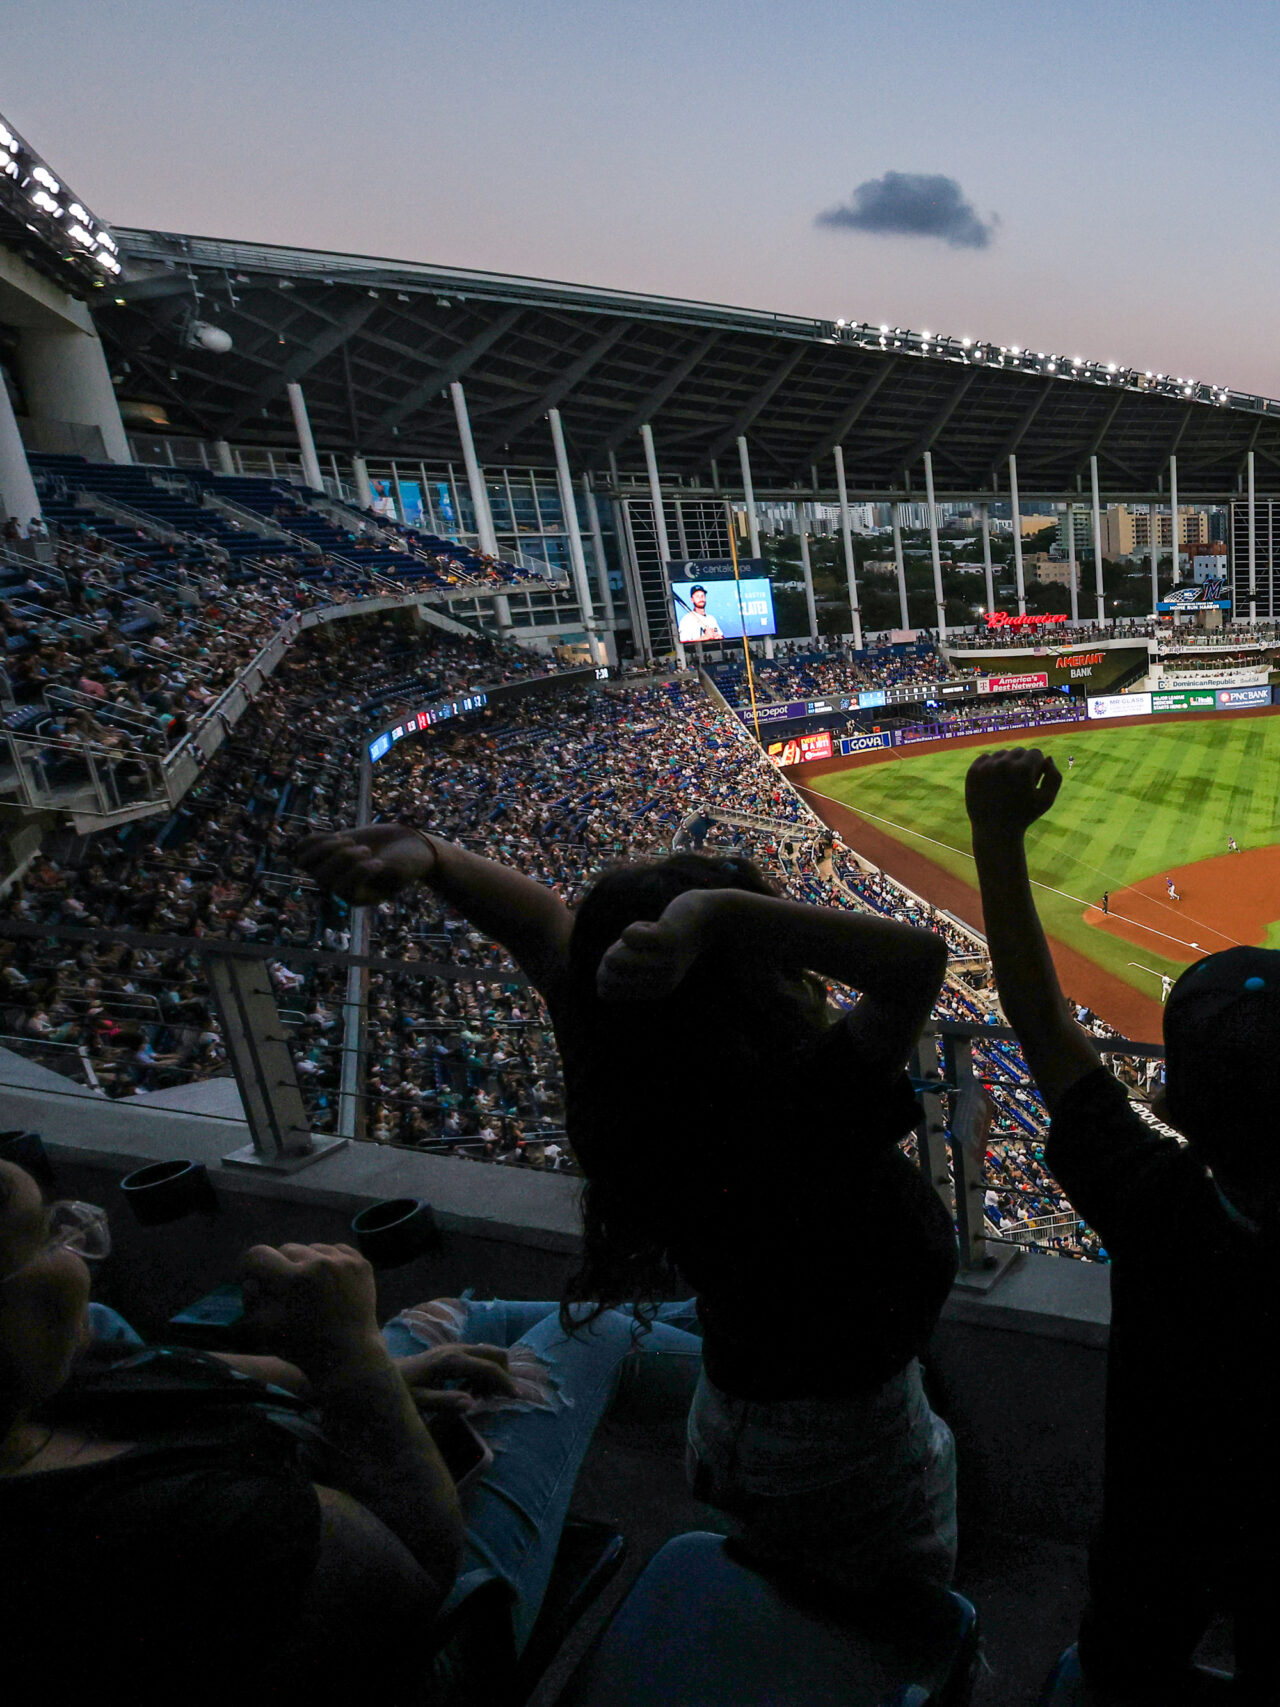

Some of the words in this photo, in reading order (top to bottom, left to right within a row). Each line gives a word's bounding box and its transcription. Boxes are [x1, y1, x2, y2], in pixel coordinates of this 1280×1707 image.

[703, 564, 751, 574] cantalope
[984, 611, 1068, 628] Budweiser
[1056, 653, 1104, 668] AMERANT
[1070, 667, 1092, 679] BANK
[999, 675, 1038, 684] America's
[993, 684, 1011, 692] Best
[1012, 681, 1044, 690] Network
[1230, 691, 1247, 701] PNC
[1249, 690, 1268, 699] BANK
[851, 736, 882, 750] GOYA
